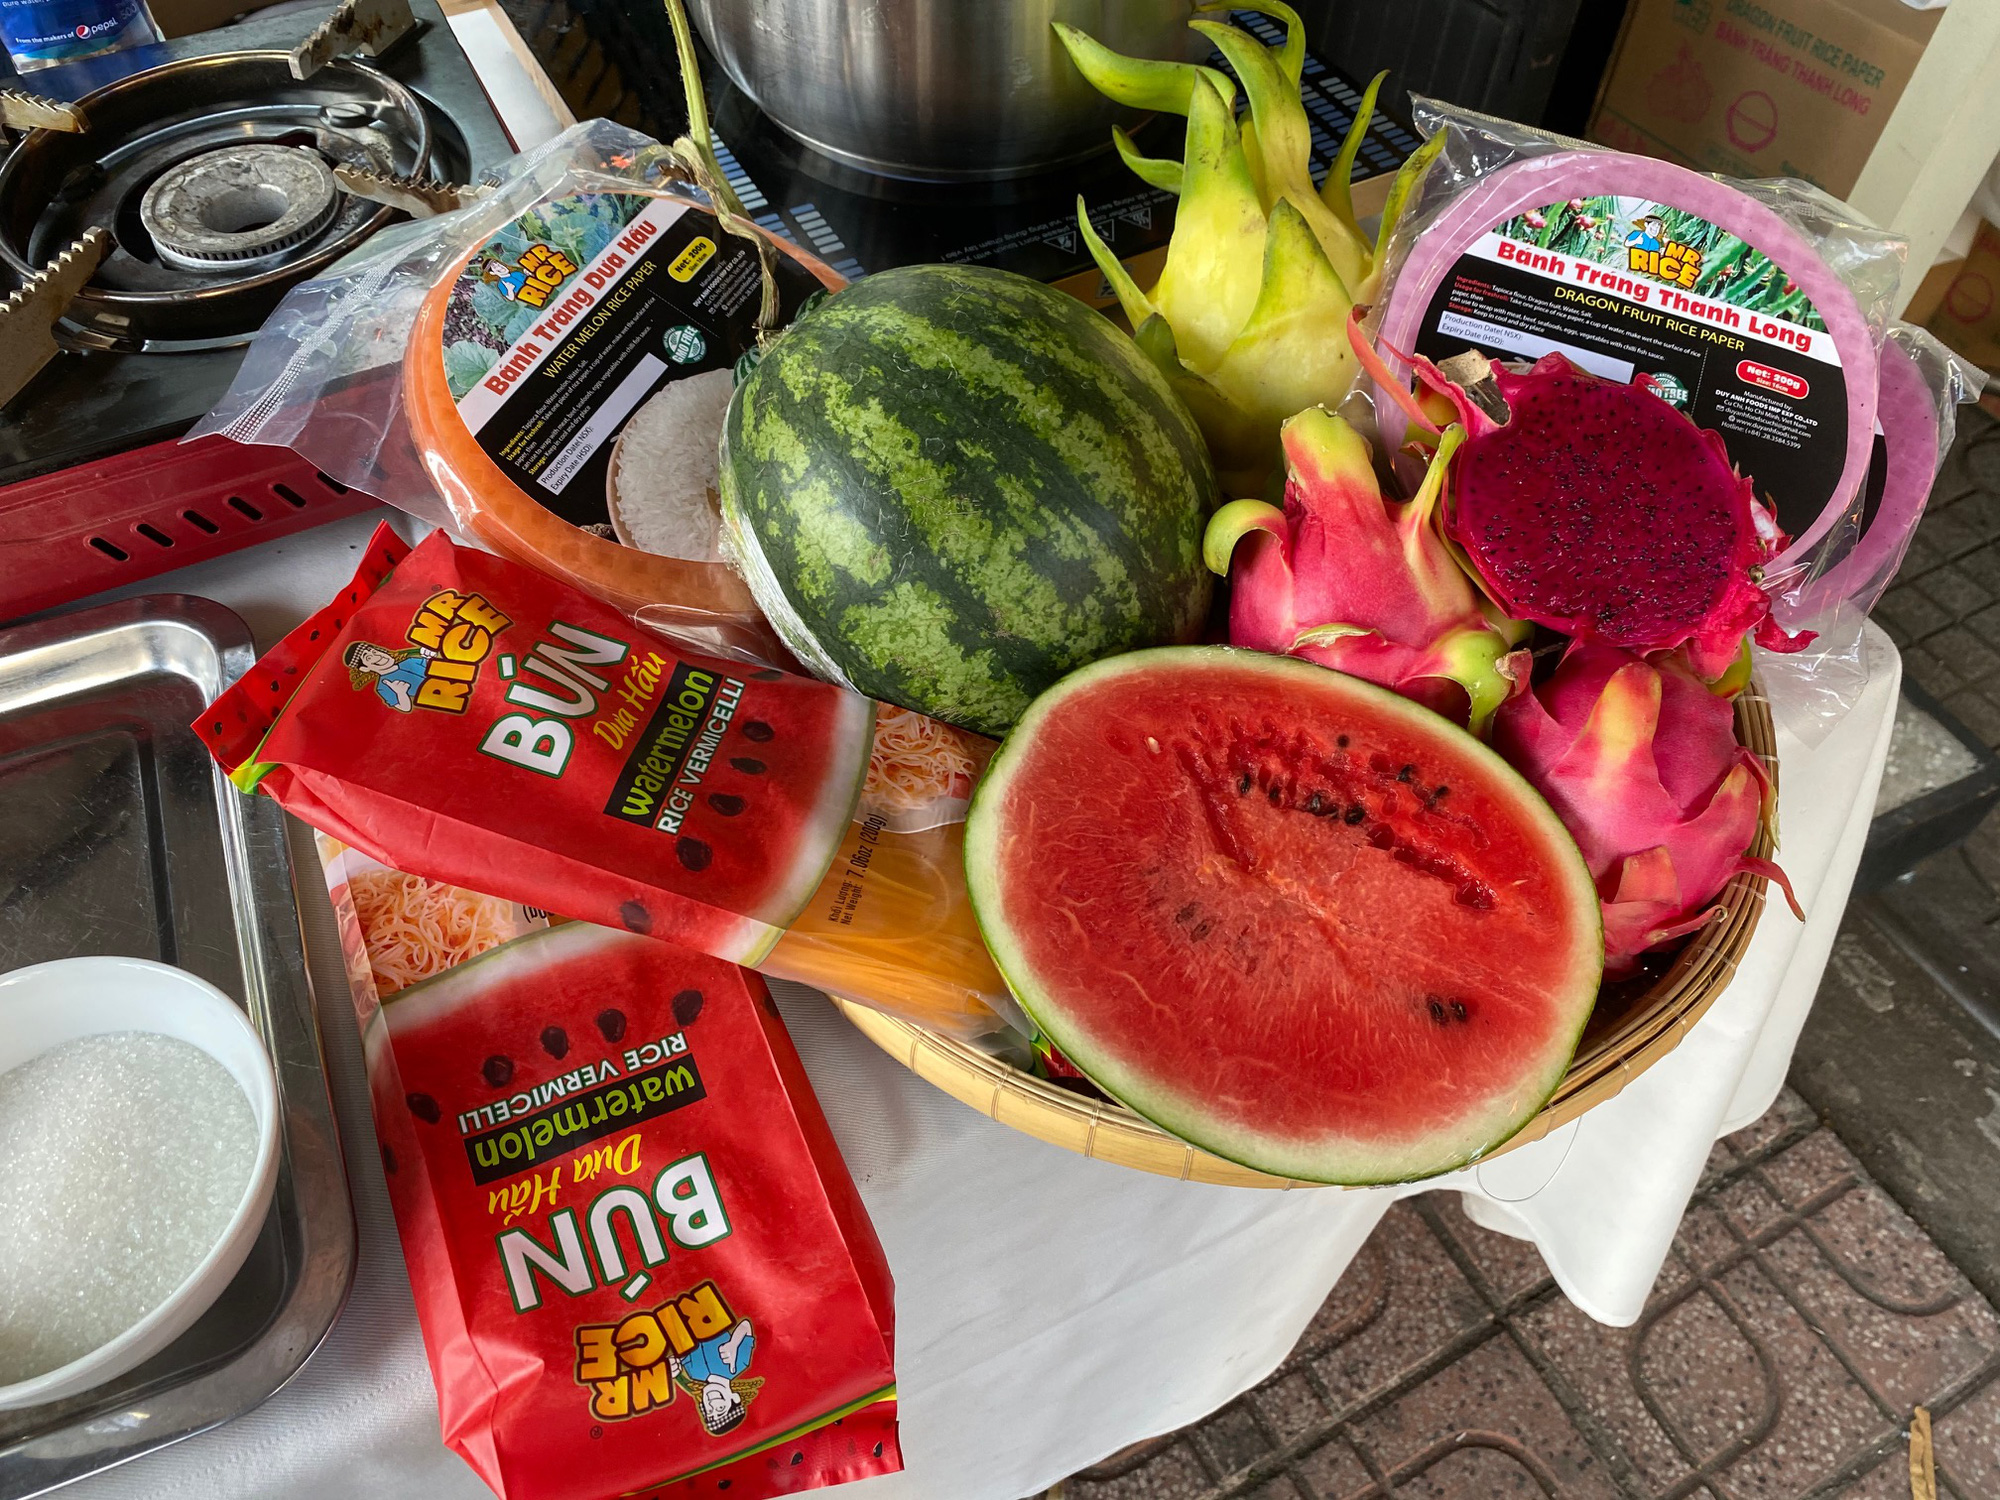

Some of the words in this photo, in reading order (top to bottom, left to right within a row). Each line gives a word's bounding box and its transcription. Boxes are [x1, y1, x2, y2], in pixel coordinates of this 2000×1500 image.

[43, 34, 67, 42] makers
[91, 17, 118, 34] pepsi
[1772, 18, 1814, 52] FRUIT
[1808, 36, 1845, 68] RICE
[1838, 52, 1886, 89] PAPER
[516, 238, 554, 275] MR
[674, 255, 692, 274] Net:
[687, 240, 707, 259] 200g
[1623, 244, 1703, 290] RICE
[1663, 240, 1704, 267] MR
[511, 247, 579, 314] RICE
[1451, 288, 1469, 298] paper,
[1470, 293, 1483, 301] then
[1491, 284, 1513, 296] Tapioca
[1513, 291, 1528, 301] flour,
[1527, 295, 1548, 307] Dragon
[1548, 301, 1562, 310] fruit,
[1561, 305, 1580, 315] Water,
[1580, 310, 1593, 318] Salt.
[1495, 240, 1567, 276] Bánh
[1570, 260, 1653, 303] Tráng
[1655, 288, 1742, 328] Thanh
[1745, 315, 1814, 353] Long
[481, 335, 544, 399] Bánh
[530, 282, 596, 349] Tráng
[582, 247, 627, 292] Dưa
[614, 213, 658, 257] Hấu
[540, 339, 581, 381] WATER
[573, 306, 612, 346] MELON
[605, 285, 632, 312] RICE
[624, 258, 657, 291] PAPER
[1444, 312, 1483, 330] Production
[1453, 281, 1472, 292] Usage
[1509, 297, 1521, 305] Take
[1533, 304, 1548, 314] piece
[1566, 314, 1584, 324] paper,
[1589, 319, 1601, 329] cup
[1607, 325, 1625, 335] water,
[1625, 330, 1641, 339] make
[1662, 341, 1683, 352] surface
[1473, 308, 1488, 318] Keep
[1494, 314, 1507, 322] cool
[1506, 317, 1518, 325] and
[1518, 321, 1528, 329] dry
[1529, 323, 1545, 334] place
[1553, 285, 1620, 314] DRAGON
[1621, 304, 1665, 327] FRUIT
[1664, 317, 1698, 337] RICE
[1698, 328, 1746, 352] PAPER
[671, 342, 689, 363] GMO
[680, 325, 698, 345] FREE
[1441, 322, 1463, 335] Expiry
[1464, 328, 1482, 339] Date
[1477, 302, 1493, 312] wrap
[1493, 306, 1506, 314] with
[1505, 310, 1522, 320] meat,
[1522, 314, 1536, 323] beef,
[1536, 318, 1563, 331] seafoods,
[1563, 327, 1578, 337] eggs,
[1578, 330, 1609, 345] vegetables
[1609, 339, 1623, 348] with
[1622, 343, 1636, 352] chilli
[1636, 347, 1647, 355] fish
[1647, 351, 1666, 360] sauce.
[1745, 364, 1771, 379] Net:
[1772, 373, 1801, 390] 200g
[1755, 376, 1771, 386] Size:
[1771, 382, 1789, 392] 16cm
[1714, 388, 1729, 398] DUY
[1730, 393, 1745, 403] ANH
[1745, 398, 1768, 410] FOODS
[1768, 405, 1781, 414] IMP
[1780, 409, 1794, 418] EXP
[1742, 390, 1783, 407] Manufactured
[1783, 403, 1793, 412] by:
[540, 452, 569, 484] Production
[549, 470, 569, 491] Expiry
[564, 457, 579, 474] Date
[407, 590, 465, 650] MR
[414, 594, 513, 713] RICE
[477, 620, 630, 779] BÚN
[593, 707, 639, 750] Dưa
[621, 671, 714, 816] watermelon
[656, 787, 695, 834] RICE
[679, 676, 747, 785] VERMICELLI
[858, 811, 887, 844] (200g)
[846, 843, 872, 877] 7.06oz
[840, 911, 853, 925] Net
[623, 1031, 688, 1072] RICE
[458, 1059, 621, 1134] VERMICELLI
[474, 1065, 697, 1168] watermelon
[572, 1133, 642, 1183] Dưa
[494, 1151, 733, 1315] BÚN
[575, 1279, 738, 1385] RICE
[593, 1360, 674, 1420] MR
